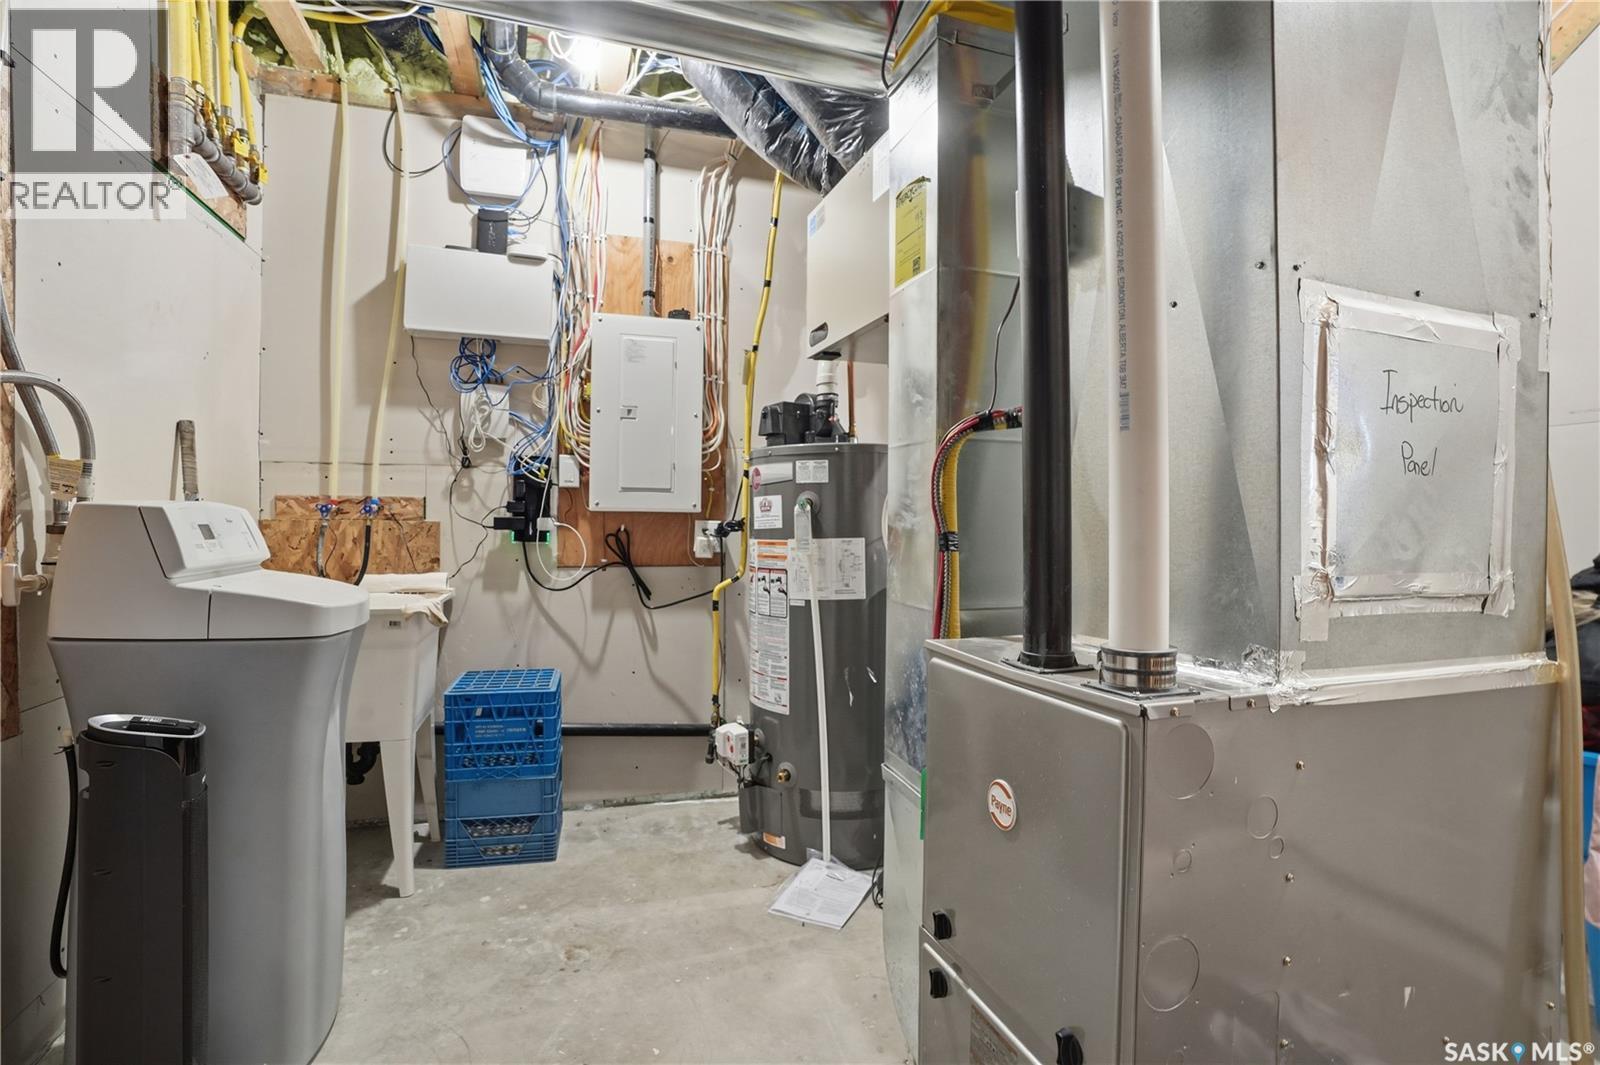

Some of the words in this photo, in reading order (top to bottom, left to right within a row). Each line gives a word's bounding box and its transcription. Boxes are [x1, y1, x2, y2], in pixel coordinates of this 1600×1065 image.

[1380, 369, 1464, 423] Inspection
[1401, 441, 1438, 477] Panel
[991, 794, 1013, 817] Payne
